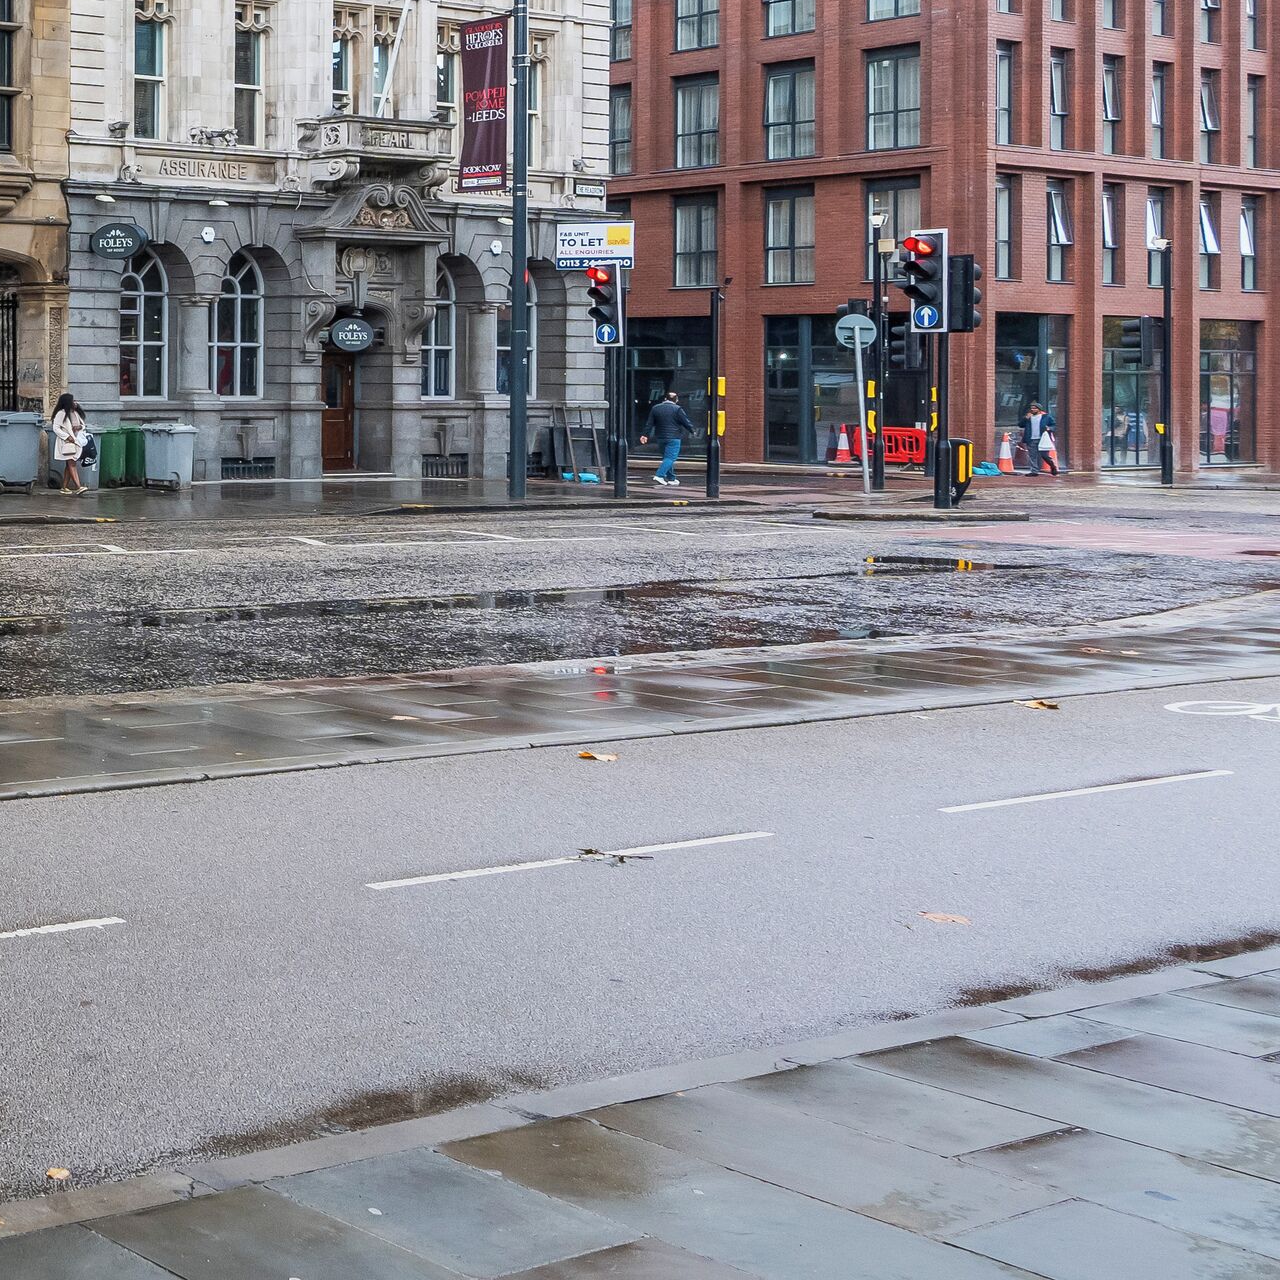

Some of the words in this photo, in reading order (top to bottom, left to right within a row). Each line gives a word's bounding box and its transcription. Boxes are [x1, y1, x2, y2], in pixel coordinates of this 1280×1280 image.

[466, 28, 503, 45] HEROES
[465, 87, 506, 103] POMPEII
[476, 98, 506, 111] ROME
[472, 108, 506, 123] LEEDS
[159, 158, 248, 181] ASSURANCE
[463, 165, 482, 174] BOOK
[482, 163, 502, 172] NOW
[99, 237, 133, 248] FOLEYS
[560, 238, 577, 247] TO
[581, 238, 604, 247] LET
[338, 331, 368, 340] FOLEYS
